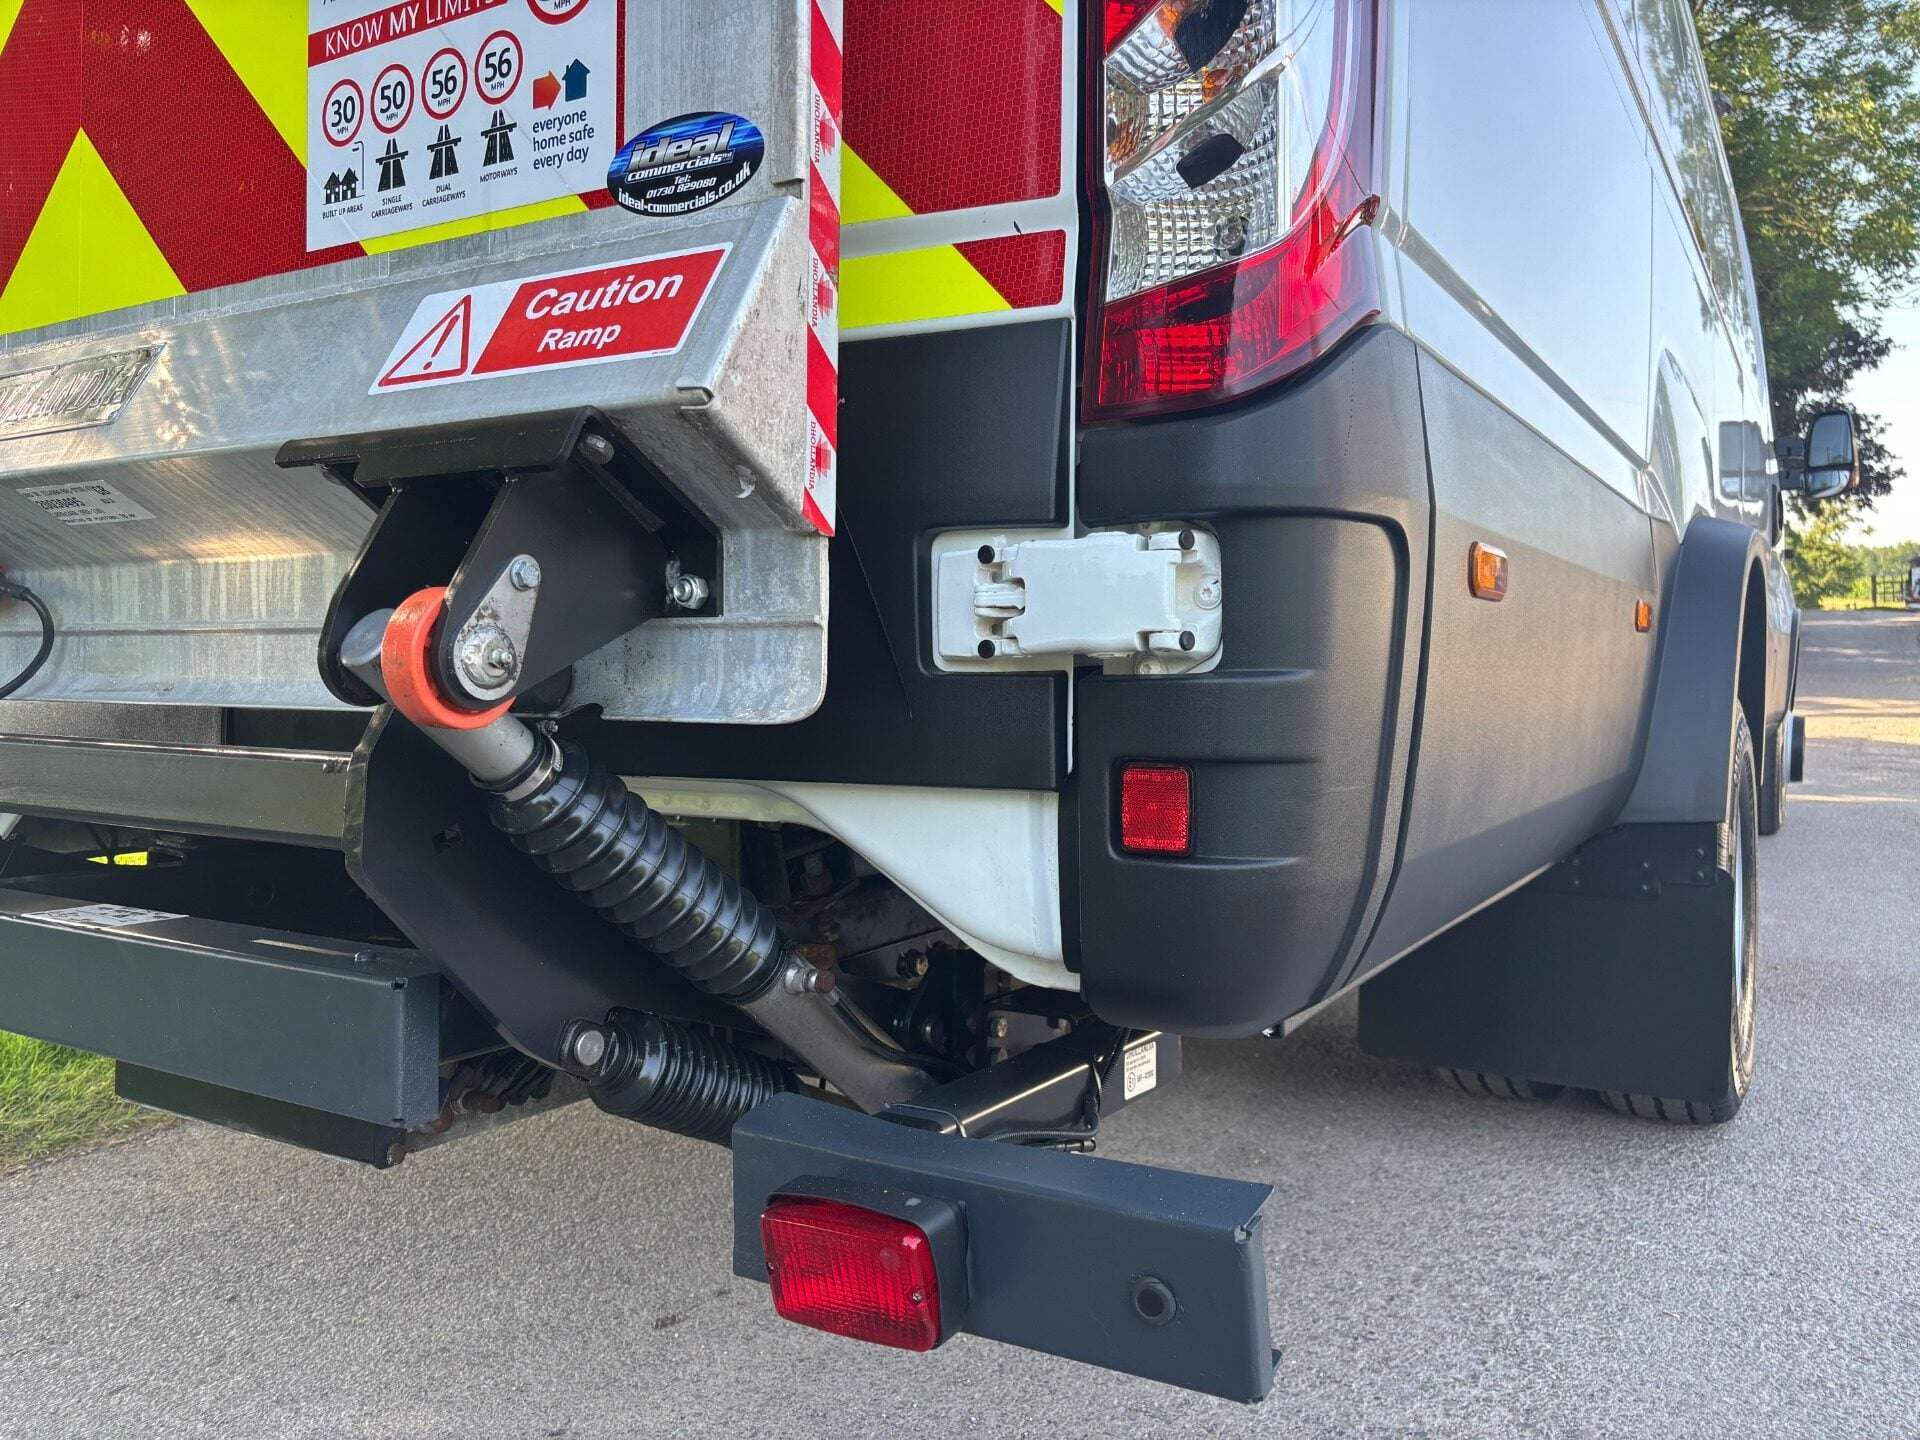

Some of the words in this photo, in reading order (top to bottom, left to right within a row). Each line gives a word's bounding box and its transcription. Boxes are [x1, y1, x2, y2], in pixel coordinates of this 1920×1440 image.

[325, 15, 384, 57] KNOW
[389, 2, 420, 36] MY
[426, 0, 494, 24] LIM
[484, 47, 512, 83] 56
[431, 64, 457, 99] 56
[490, 80, 505, 91] MPH
[380, 80, 405, 114] 50
[437, 97, 451, 107] MPH
[331, 95, 355, 127] 30
[386, 112, 399, 122] MPH
[532, 110, 587, 133] everyone
[337, 125, 348, 135] MPH
[532, 132, 566, 152] home
[568, 124, 595, 143] safe
[533, 152, 564, 170] every
[566, 146, 589, 163] day
[627, 121, 735, 172] ideal
[480, 166, 518, 183] MOTORWAYS
[628, 152, 722, 181] commercials
[436, 183, 452, 193] DUAL
[618, 160, 751, 214] ideal-commercials.co.uk
[646, 185, 675, 199] 01730
[677, 177, 717, 193] 829080
[674, 174, 691, 185] Tel:
[382, 194, 402, 206] SINGLE
[421, 190, 466, 207] CARRIAGEWAYS
[322, 209, 337, 220] BUILT
[338, 206, 346, 216] UP
[346, 203, 363, 214] AREAS
[371, 203, 413, 219] CARRIAGEWAYS
[525, 274, 684, 320] Caution
[811, 257, 819, 327] DHOLLANDIA
[537, 324, 621, 353] Ramp
[808, 421, 817, 490] DHOLLANDIA
